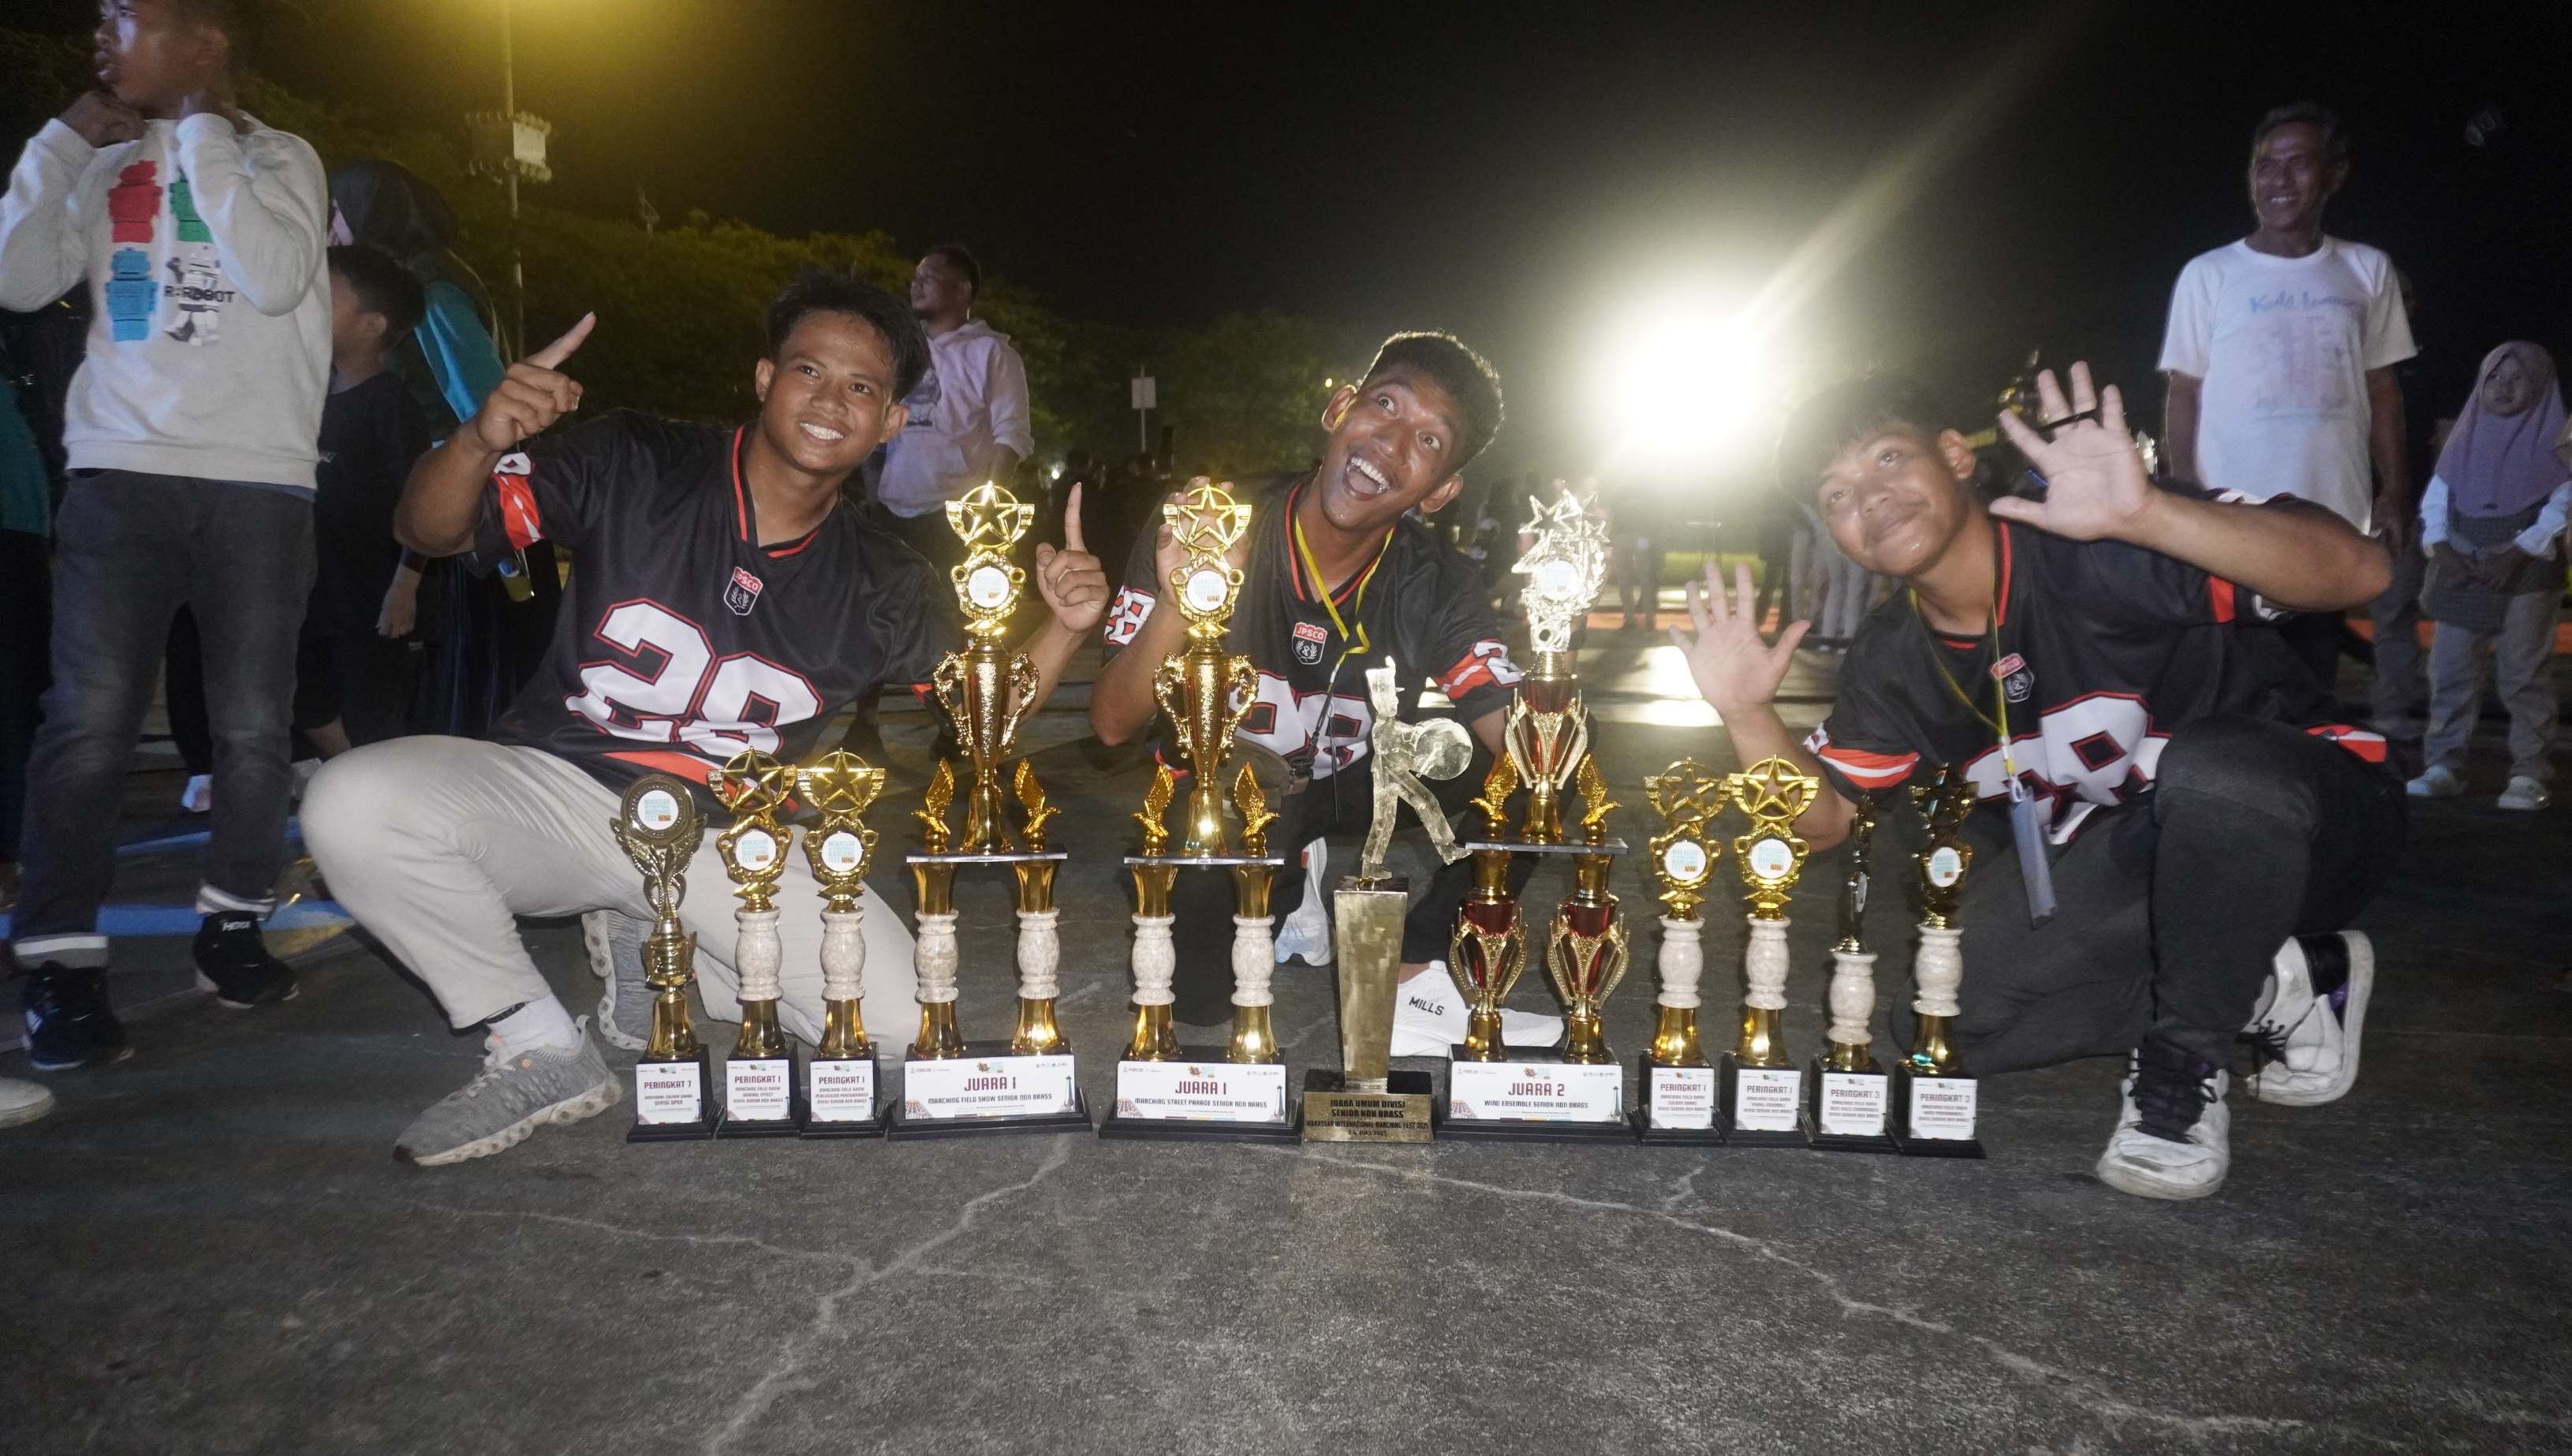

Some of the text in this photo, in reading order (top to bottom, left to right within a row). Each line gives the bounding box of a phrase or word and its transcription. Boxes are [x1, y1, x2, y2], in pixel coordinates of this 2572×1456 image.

[1296, 626, 1324, 640] JPSCO
[565, 597, 823, 757] 28
[1409, 996, 1445, 1017] MILLS
[644, 1081, 685, 1089] PERINGKAT
[819, 1076, 860, 1085] PERINGKAT
[964, 1076, 1008, 1092] JUARA
[1175, 1081, 1219, 1095] JUARA
[1508, 1082, 1566, 1097] JUARA 2
[1746, 1085, 1787, 1094] PERINGKAT
[1831, 1089, 1874, 1098] PERINGKAT
[1355, 1099, 1380, 1108] UMUM
[1920, 1093, 1962, 1103] PERINGKAT
